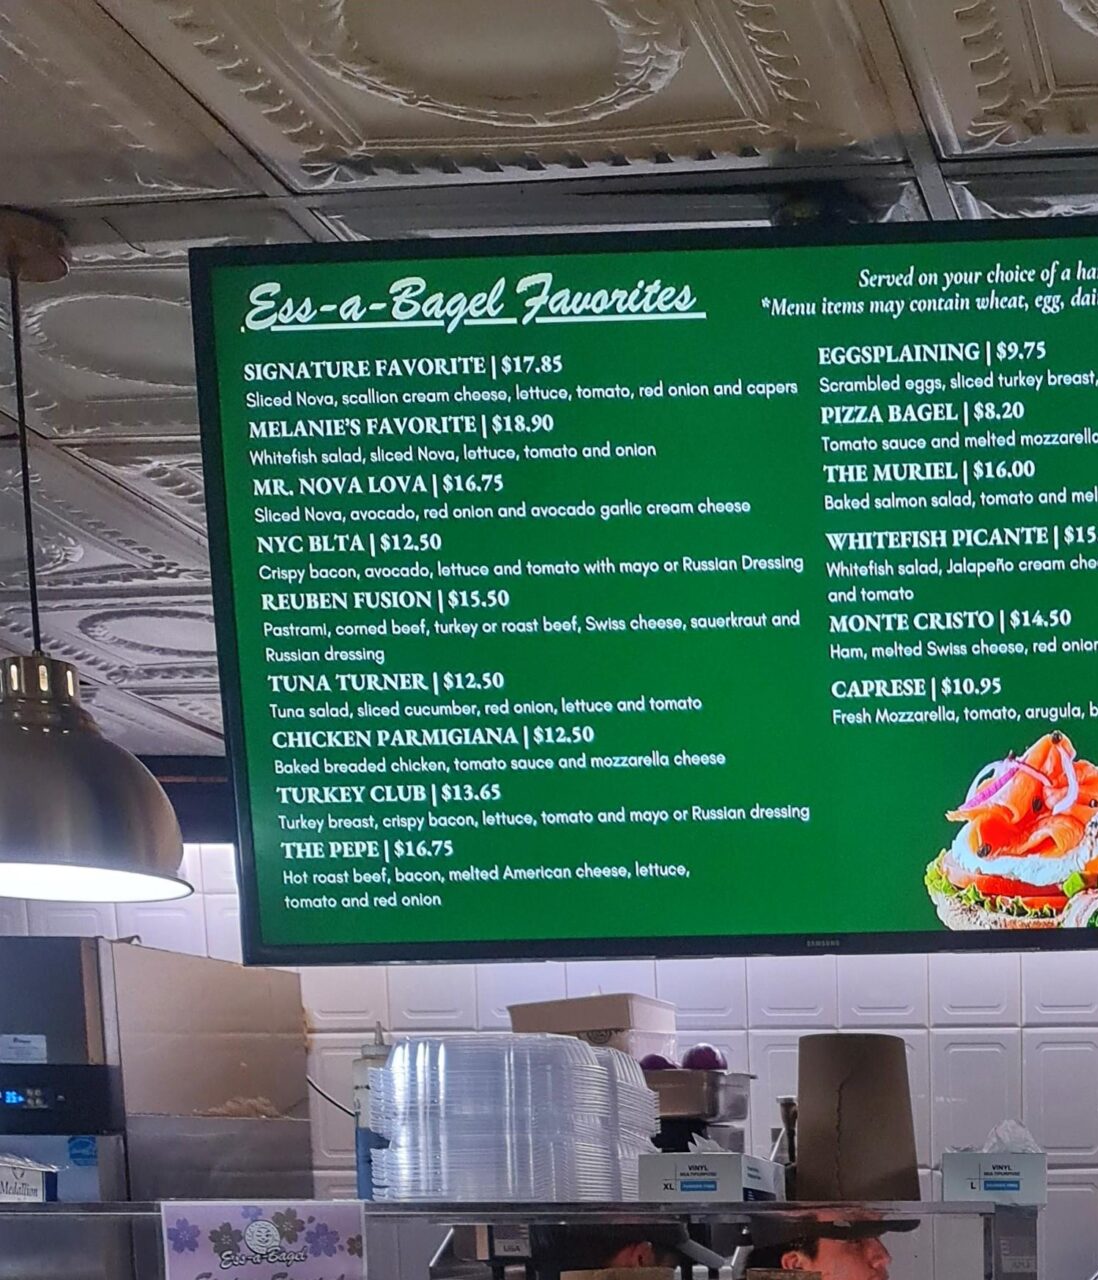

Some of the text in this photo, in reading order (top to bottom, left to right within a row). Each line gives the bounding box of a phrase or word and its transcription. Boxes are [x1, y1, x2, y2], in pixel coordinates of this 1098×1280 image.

[858, 266, 914, 287] Served
[918, 272, 938, 286] on
[942, 271, 982, 291] your
[987, 263, 1036, 284] choice
[1040, 260, 1059, 288] of
[1062, 269, 1070, 280] a
[245, 273, 696, 333] Ess-a-Bagel Favorites
[821, 296, 865, 315] items
[869, 299, 905, 319] may
[909, 292, 970, 313] contain
[975, 289, 1029, 311] wheat,
[1034, 294, 1065, 315] egg,
[818, 340, 1047, 365] EGGSPLAINING $9.75
[243, 354, 563, 382] SIGNATURE FAVORITE $17.85
[366, 415, 477, 435] FAVORITE
[491, 413, 554, 435] $18.90
[820, 401, 1025, 425] PIZZA BAGEL $8.20
[821, 436, 878, 452] Tomato
[881, 438, 927, 451] sauce
[930, 431, 960, 449] and
[964, 429, 1016, 448] melted
[249, 440, 657, 466] Whitefish salad, sliced Nova, lettuce, tomato and onion
[822, 460, 1036, 483] THE MURIEL $16.00
[253, 473, 504, 496] MR. NOVA LOVA $16.75
[256, 533, 442, 554] NYC BLTA $12.50
[825, 529, 948, 551] WHITEFISH
[951, 526, 1049, 547] PICANTE
[261, 589, 510, 611] REUBEN FUSION $15.50
[829, 608, 1072, 633] MONTE CRISTO $14.50
[267, 671, 505, 693] TUNA TURNER $12.50
[831, 676, 1002, 699] CAPRESE $10.95
[832, 707, 872, 725] Fresh
[875, 705, 960, 723] Mozzarella,
[963, 706, 1021, 722] tomato,
[1024, 702, 1085, 723] arugula,
[272, 725, 595, 749] CHICKEN PARMIGIANA $12.50
[274, 749, 726, 774] Baked breaded chicken, tomato sauce and mozzarella cheese
[275, 783, 501, 804] TURKEY CLUB $13.65
[280, 839, 454, 859] THE PEPE $16.75
[220, 1247, 308, 1269] Ess-a-Bagel
